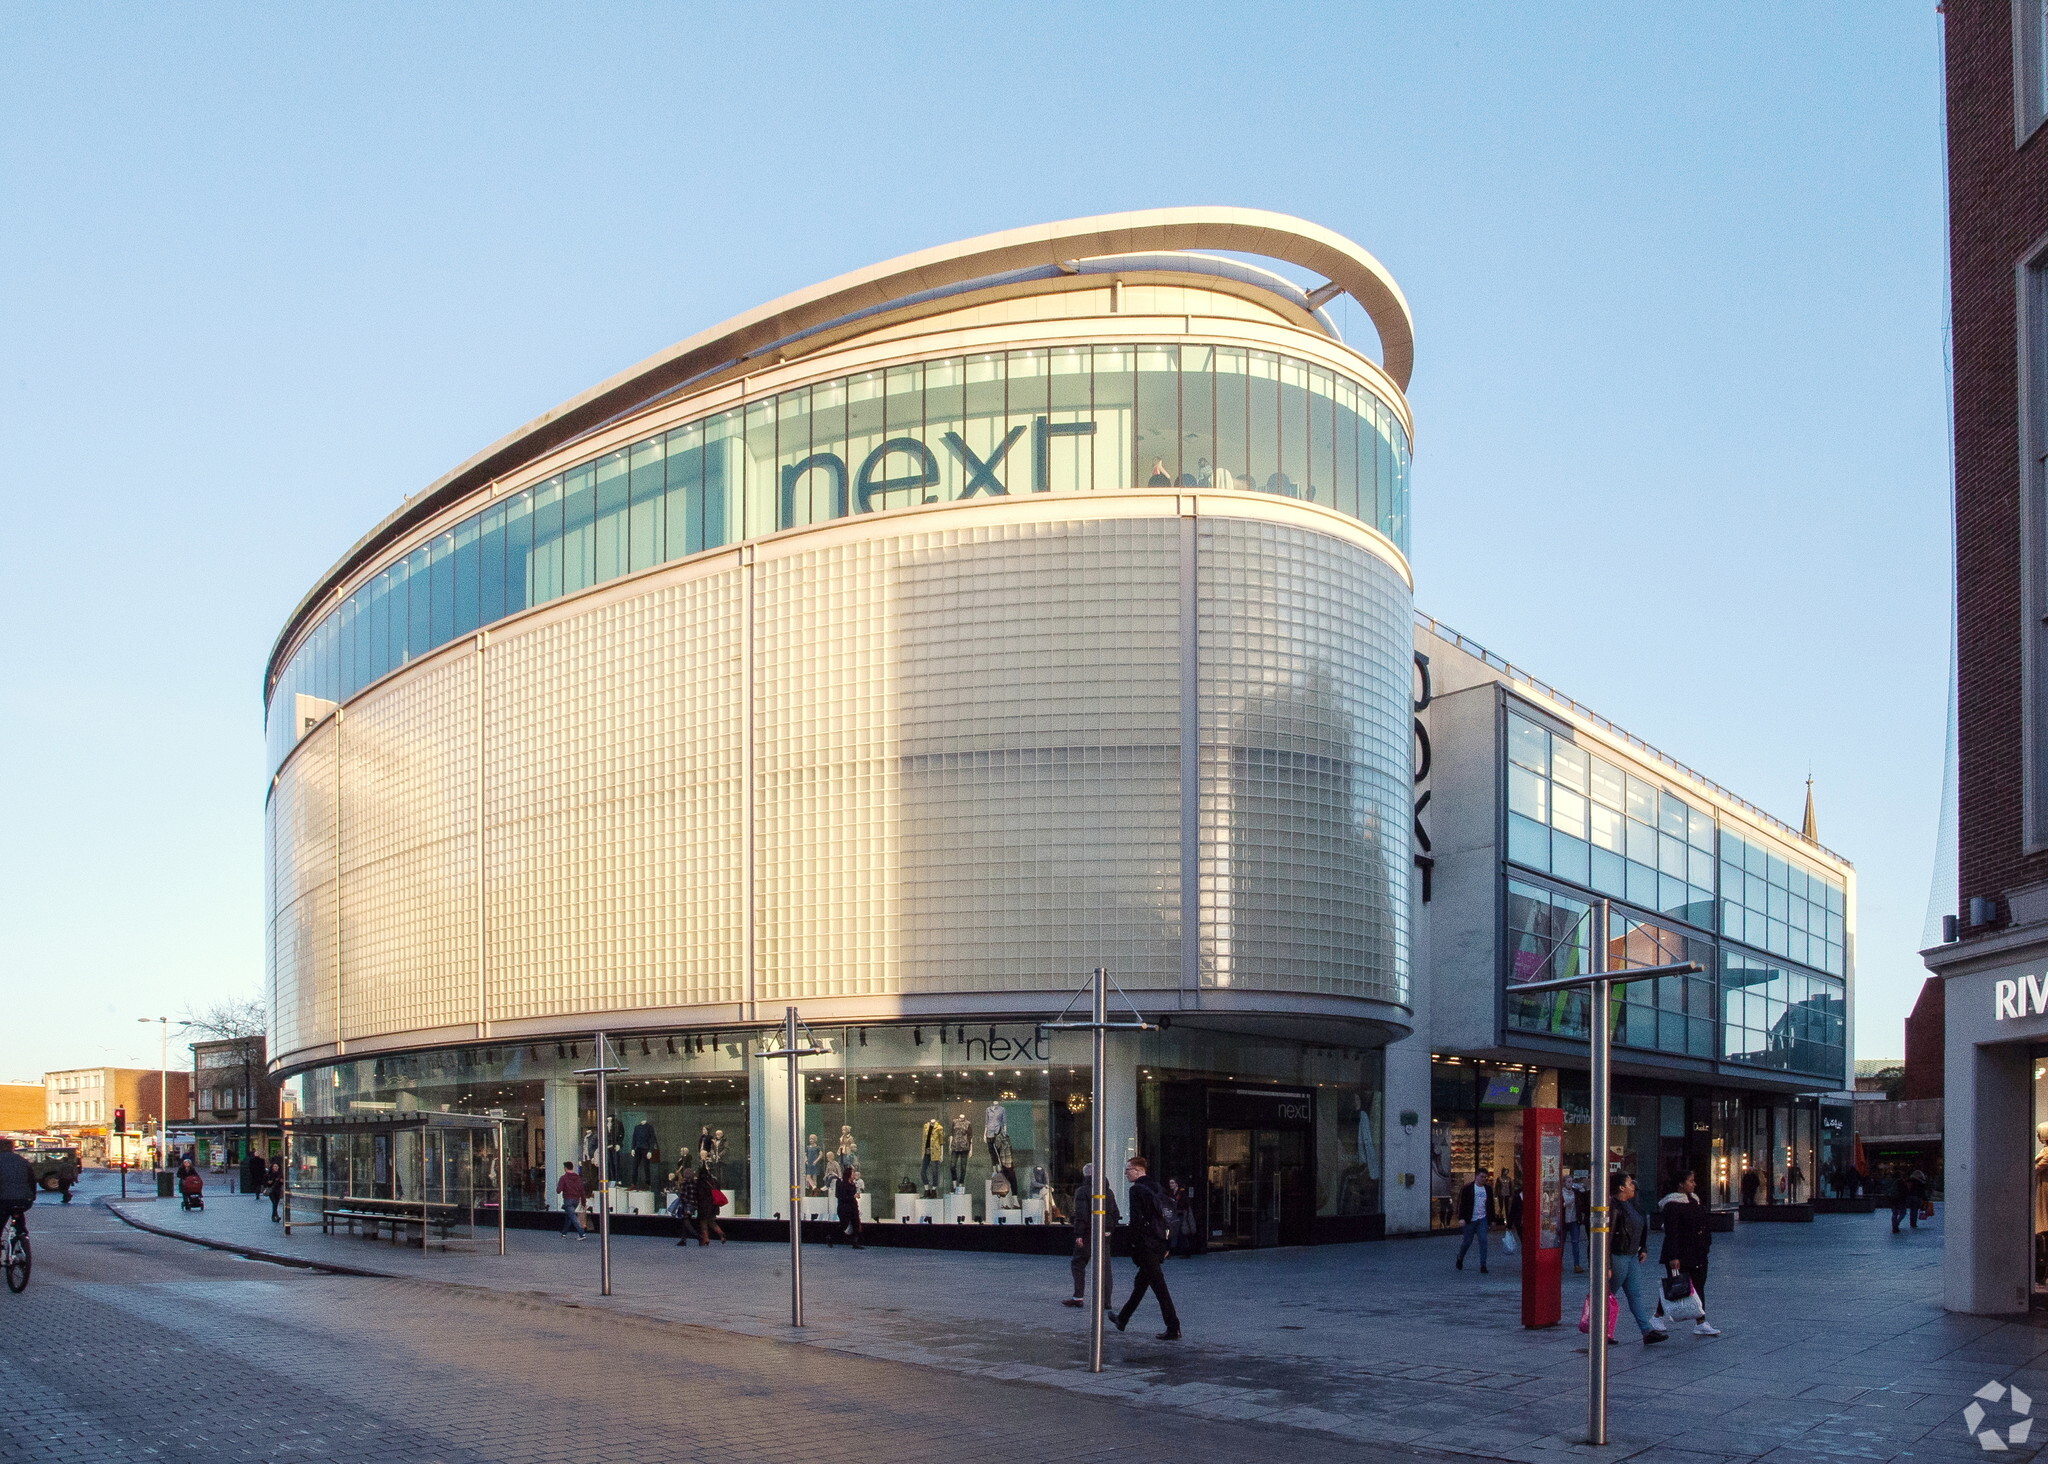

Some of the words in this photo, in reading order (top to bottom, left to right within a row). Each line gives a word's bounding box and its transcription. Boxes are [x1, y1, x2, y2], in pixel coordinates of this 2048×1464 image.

[781, 415, 1098, 529] next
[966, 1029, 1051, 1061] next
[1278, 1103, 1308, 1119] next
